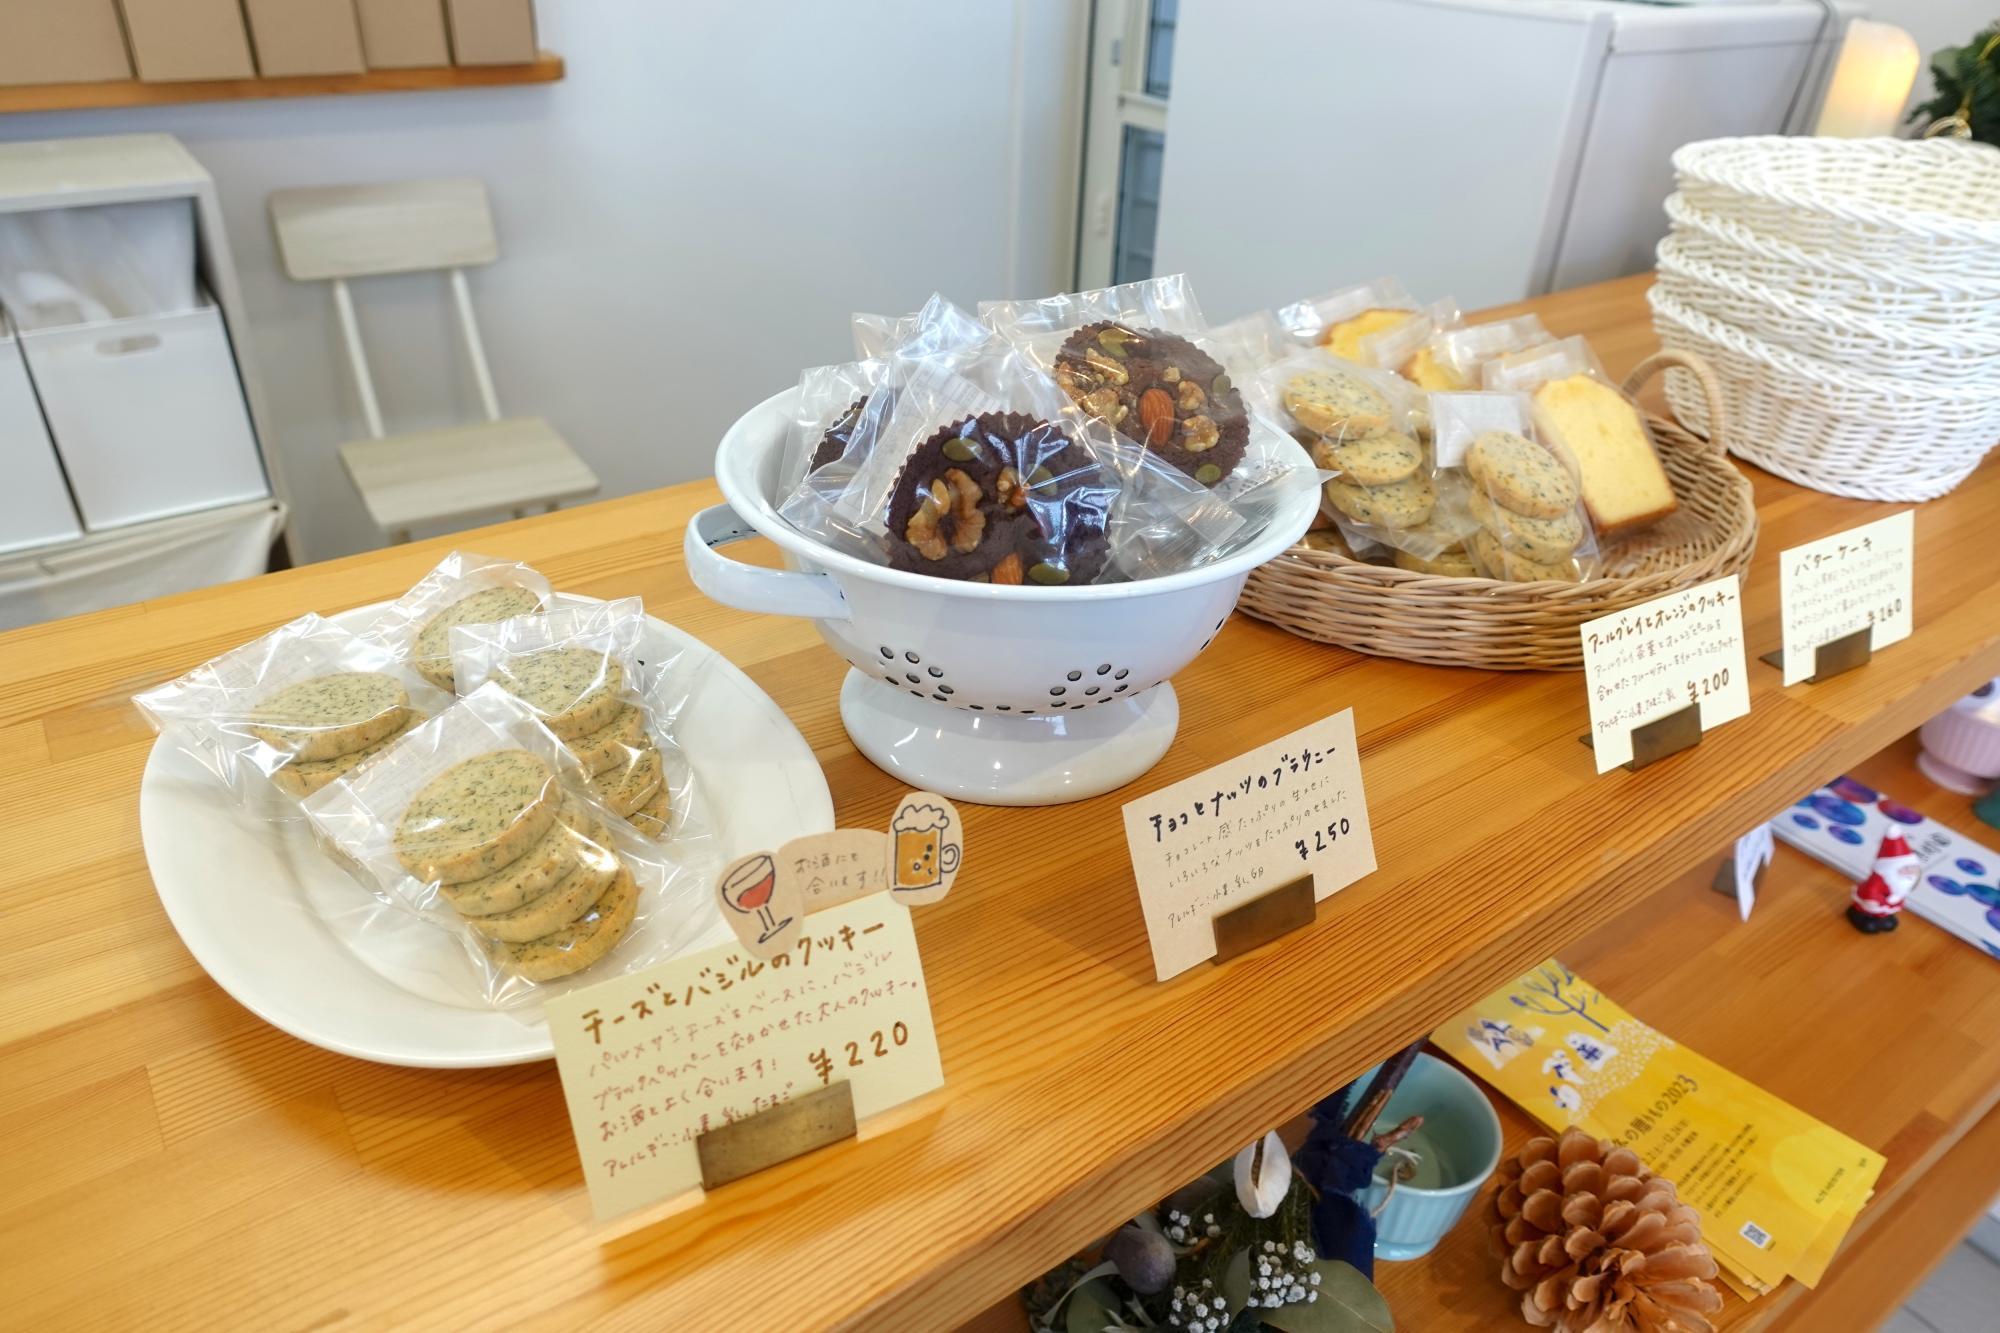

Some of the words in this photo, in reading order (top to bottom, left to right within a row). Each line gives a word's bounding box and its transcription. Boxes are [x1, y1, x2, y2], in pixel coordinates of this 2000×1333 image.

[1588, 591, 1735, 654] アールグレイとオレンジのクッキー
[1687, 668, 1730, 704] ¥200
[1149, 748, 1335, 842] チョコとナッツのブラウニー
[1295, 818, 1349, 860] ¥250
[582, 922, 884, 1044] チーズとバジルのクッキー
[808, 1021, 908, 1084] ¥220
